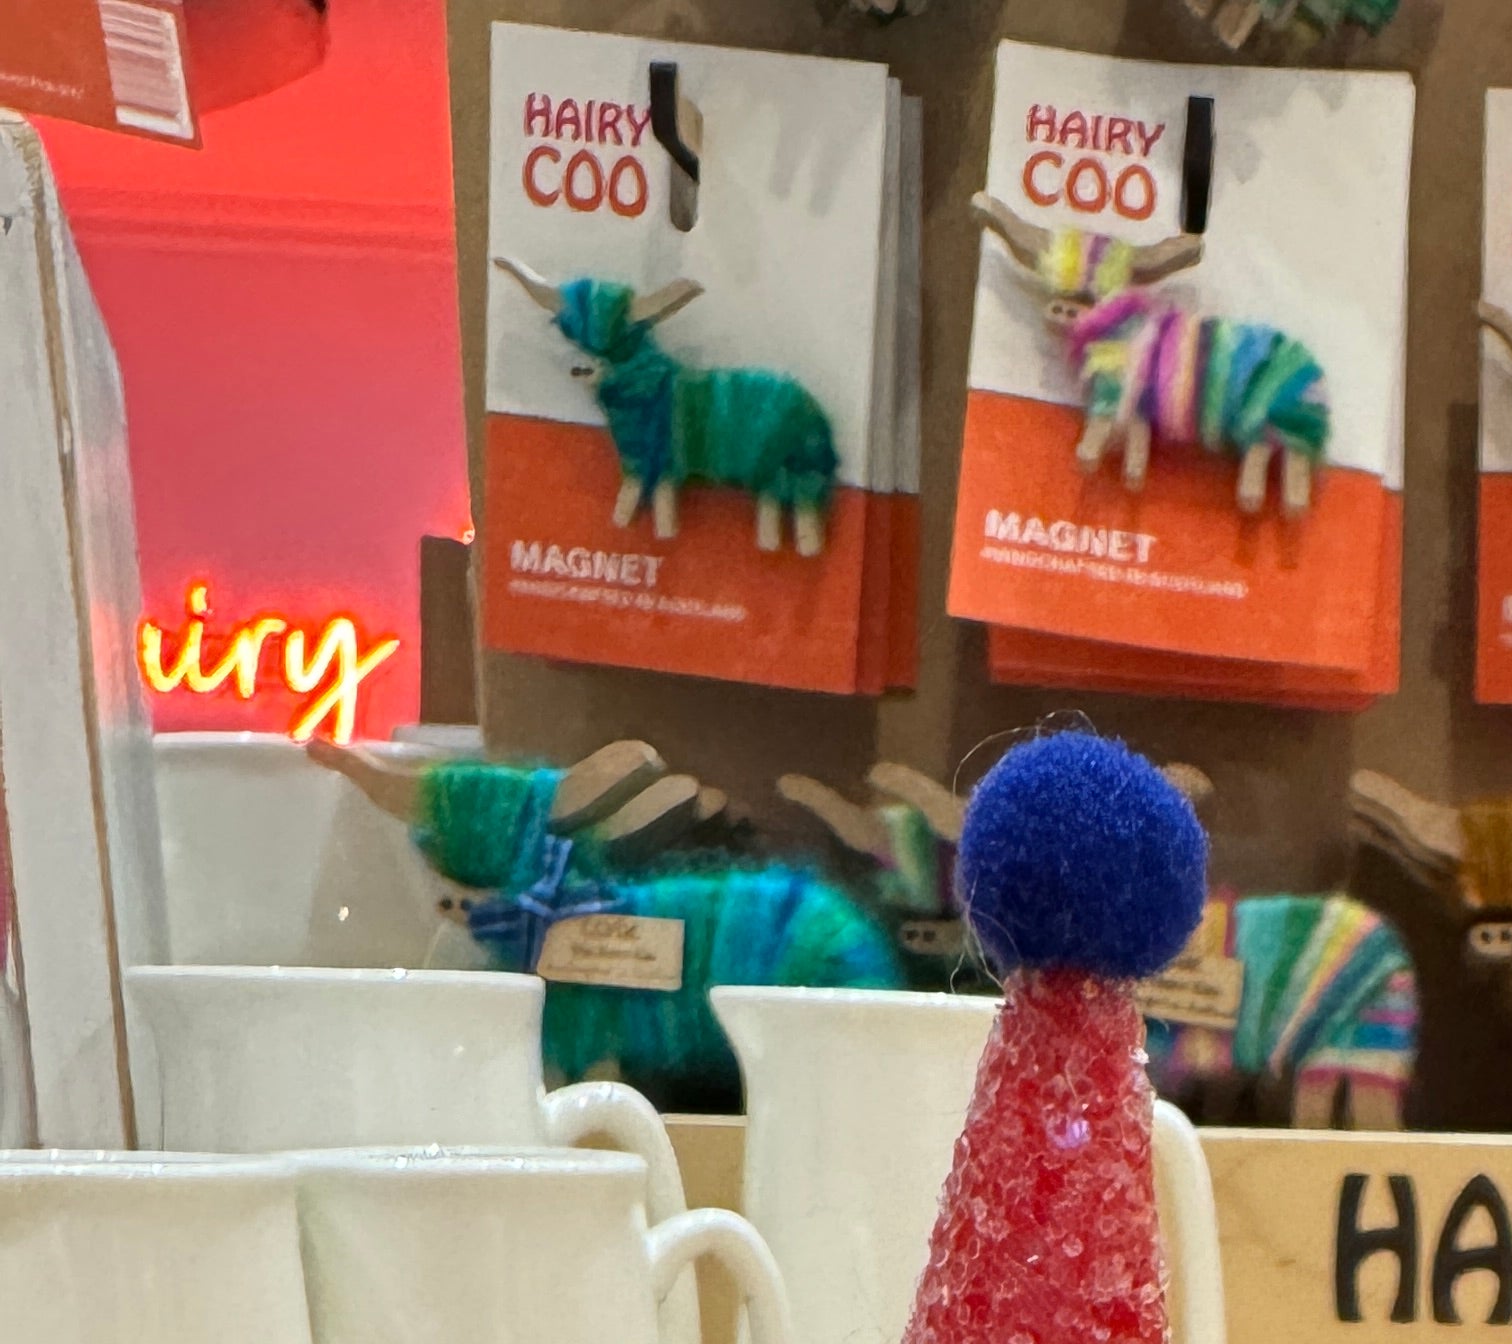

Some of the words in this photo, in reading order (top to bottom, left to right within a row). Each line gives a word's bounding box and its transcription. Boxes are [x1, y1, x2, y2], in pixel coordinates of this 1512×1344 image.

[524, 92, 651, 147] HAIRY
[1025, 104, 1165, 157] HAIRY
[522, 145, 648, 218] COO
[1022, 152, 1158, 221] COO
[984, 509, 1157, 563] MAGNET
[511, 540, 664, 587] MAGNET
